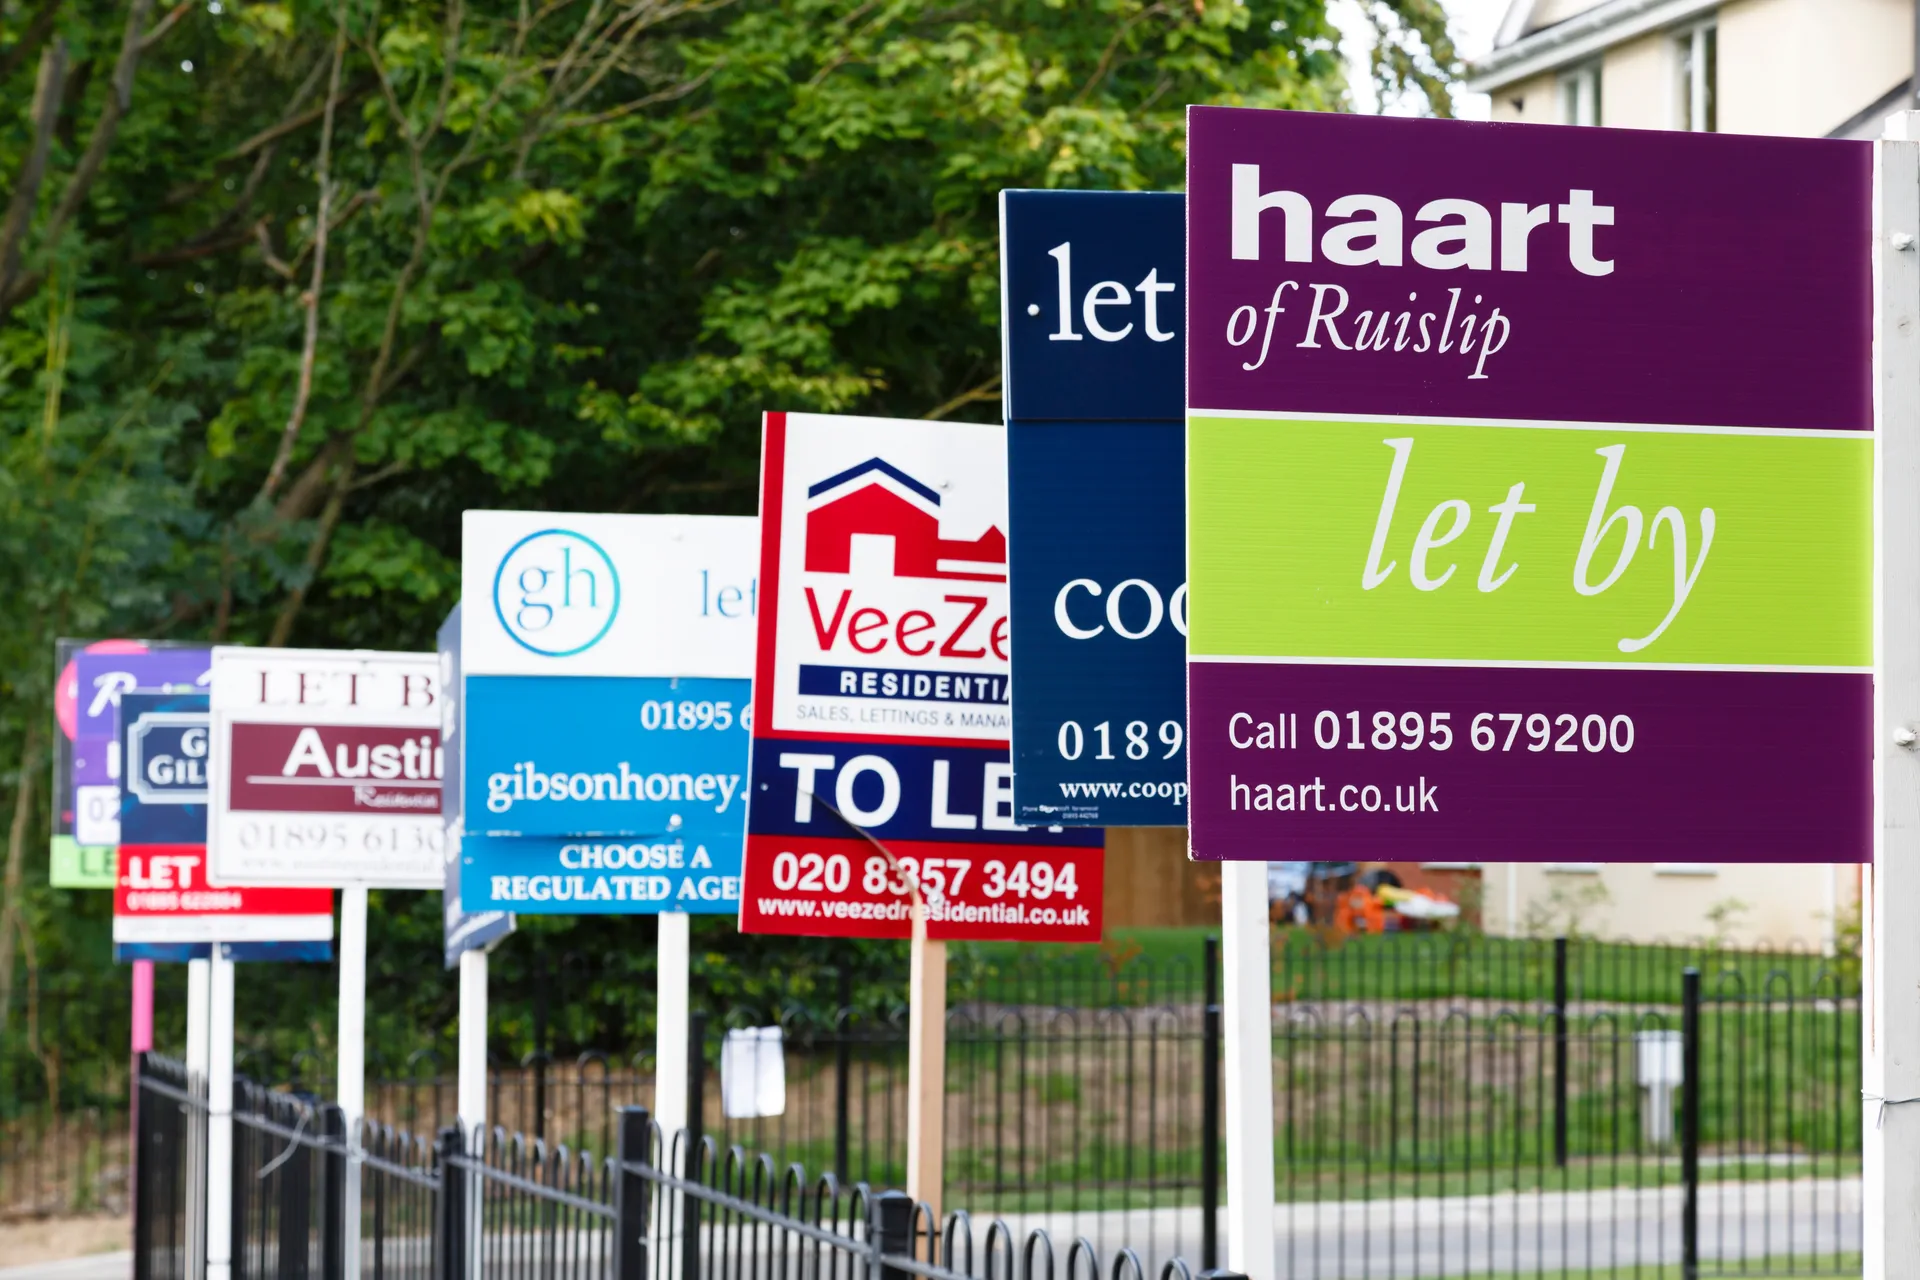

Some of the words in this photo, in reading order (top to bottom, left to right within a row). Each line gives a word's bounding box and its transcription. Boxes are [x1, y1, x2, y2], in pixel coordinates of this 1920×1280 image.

[1231, 163, 1615, 276] haart
[1048, 241, 1176, 342] let
[1226, 280, 1299, 371] of
[1296, 282, 1511, 380] Ruislip
[1362, 437, 1537, 592] let
[1573, 444, 1716, 653] by
[516, 546, 600, 631] gh
[257, 671, 377, 706] LET
[401, 674, 436, 708] B
[641, 700, 733, 731] 01895
[796, 704, 853, 724] SALES,
[860, 708, 939, 727] LETTINGS
[944, 711, 955, 727] &
[960, 713, 1009, 729] MANA
[1229, 712, 1297, 749] Call
[1314, 711, 1453, 750] 01895
[1470, 712, 1635, 753] 679200
[1057, 720, 1183, 761] 0189
[148, 754, 208, 785] GIL
[487, 761, 749, 814] gibsonhoney.
[779, 752, 901, 828] TO
[930, 759, 1063, 833] LE
[1230, 774, 1439, 815] haart.co.uk
[238, 822, 349, 851] 01895
[559, 841, 685, 869] CHOOSE
[690, 844, 712, 869] A
[129, 855, 201, 889] LET
[490, 875, 672, 901] REGULATED
[676, 875, 741, 900] AGE
[772, 851, 851, 893] 020
[862, 856, 972, 896] 8357
[982, 859, 1079, 900] 3494
